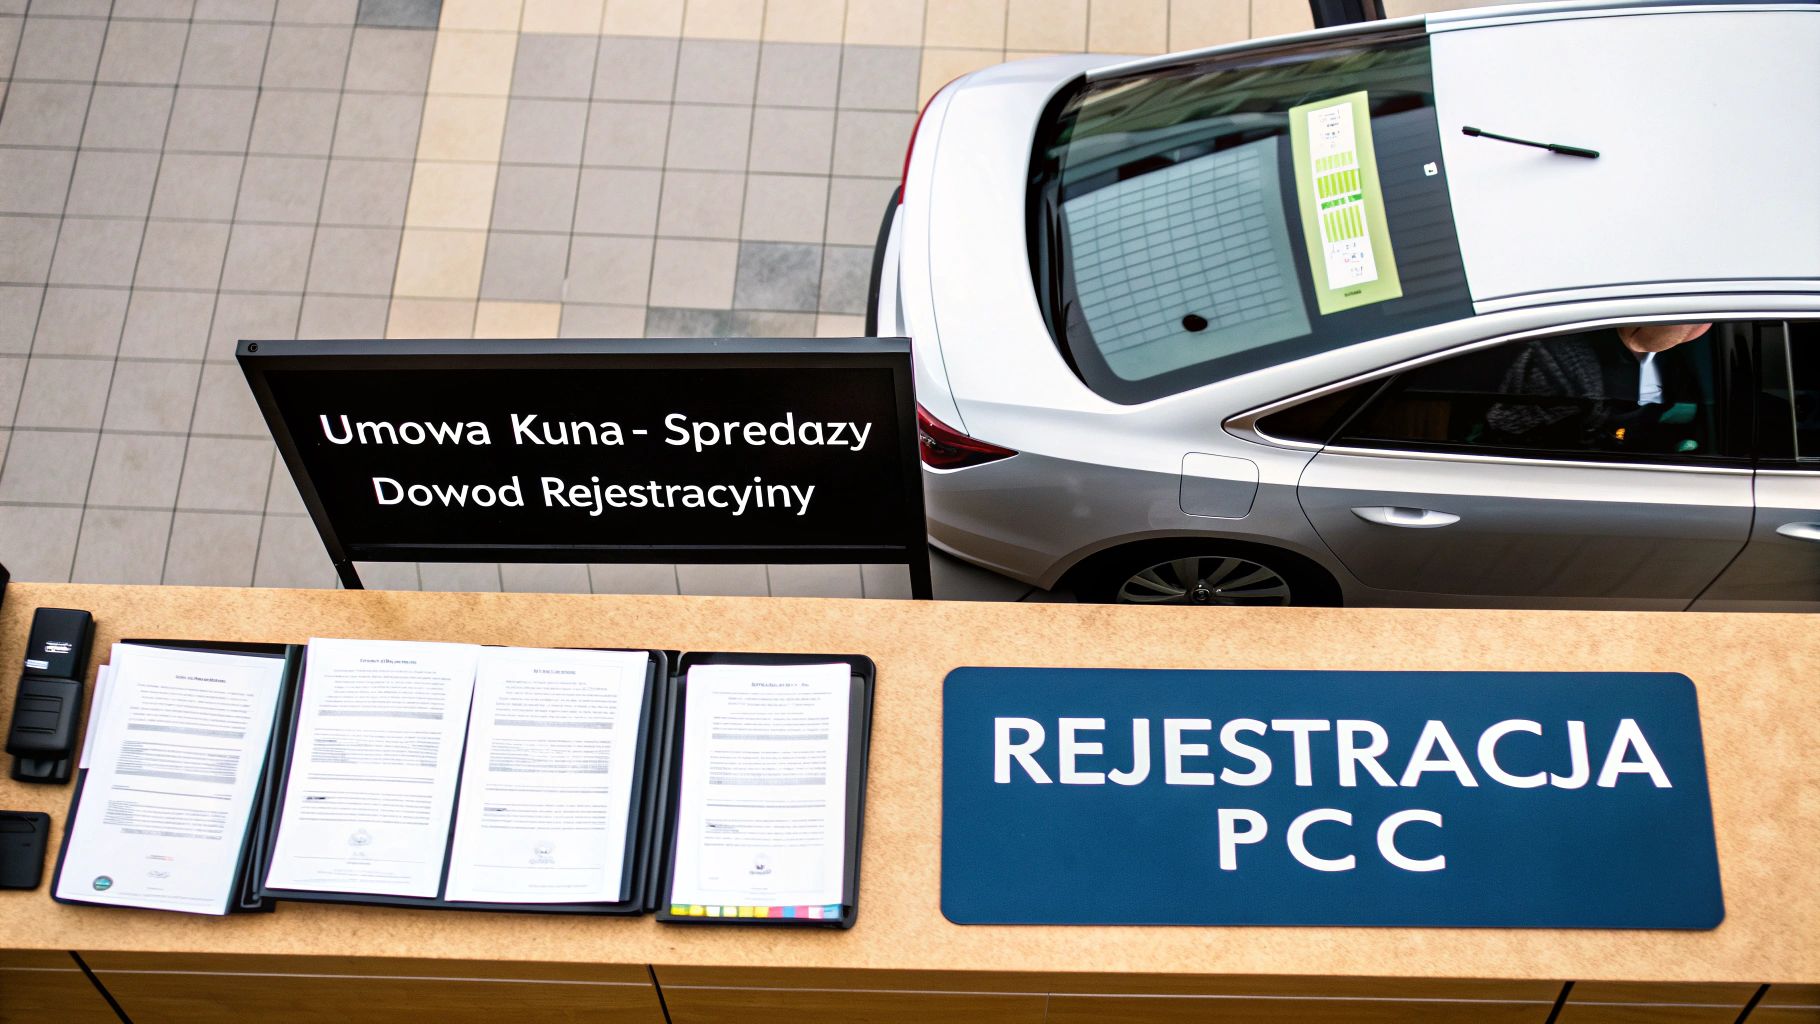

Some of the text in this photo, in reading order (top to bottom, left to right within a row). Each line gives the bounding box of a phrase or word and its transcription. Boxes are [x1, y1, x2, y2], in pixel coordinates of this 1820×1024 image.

[319, 414, 492, 446] Umowa
[664, 411, 873, 453] Spredazy
[372, 475, 816, 517] Dowod Rejestracyiny
[993, 716, 1673, 790] REJESTRACJA
[1217, 807, 1447, 873] PCC
